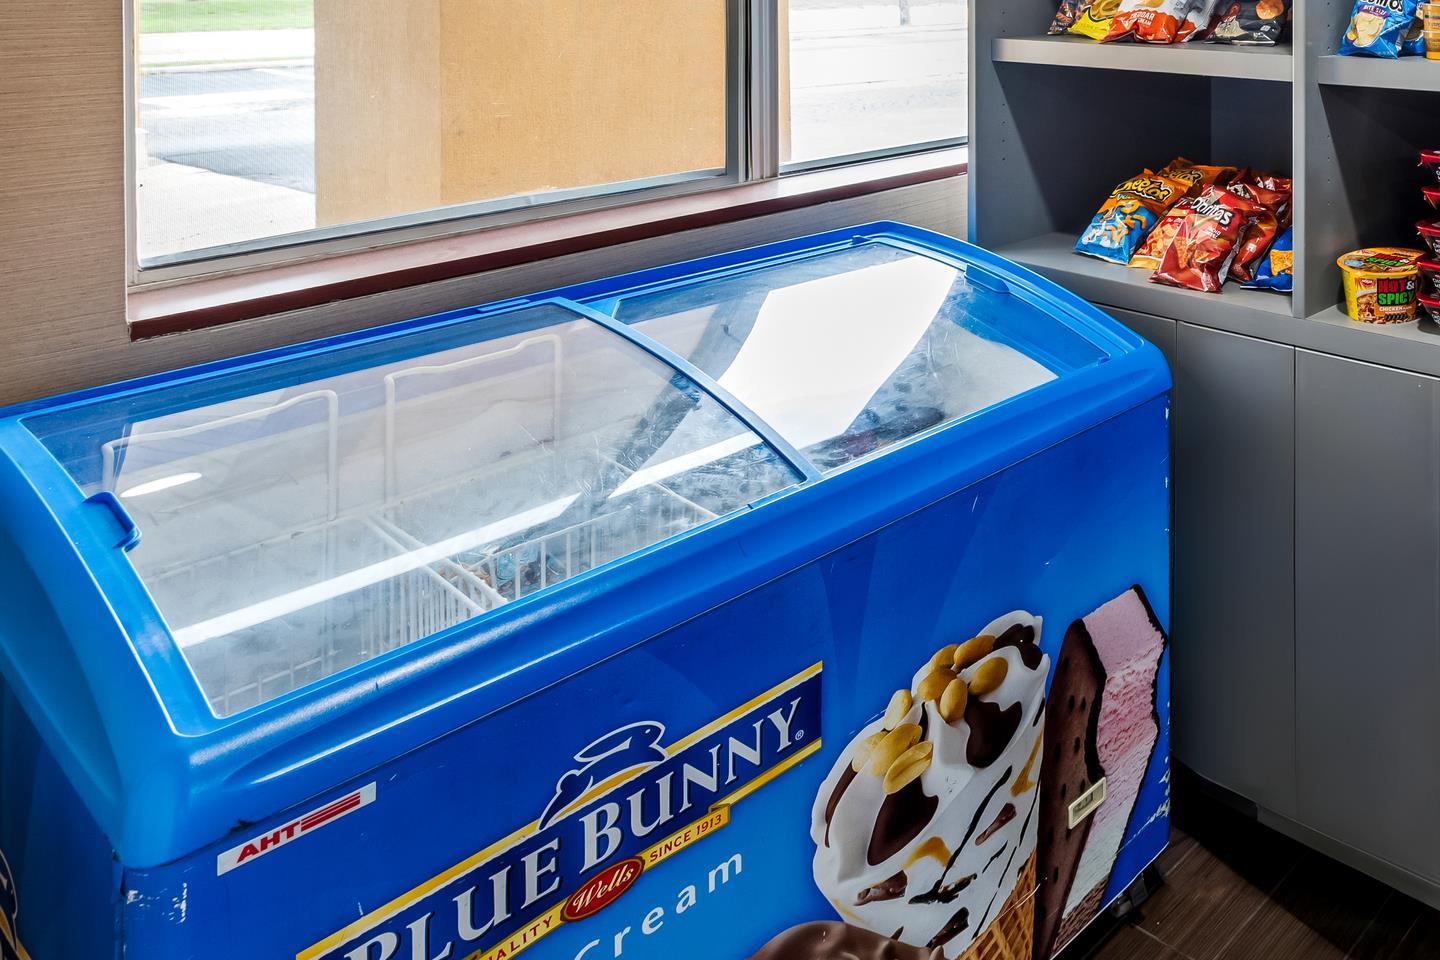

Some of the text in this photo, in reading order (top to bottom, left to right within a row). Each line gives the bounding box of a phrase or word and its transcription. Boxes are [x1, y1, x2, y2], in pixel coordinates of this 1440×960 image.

[1363, 5, 1375, 13] BITE
[1191, 196, 1233, 225] Doritos
[1378, 278, 1406, 293] HOT
[1406, 280, 1415, 290] &
[1378, 292, 1414, 305] SPICY
[579, 696, 803, 875] BUNNY
[237, 819, 301, 864] AHT
[649, 812, 724, 864] SINCE 1913
[571, 863, 634, 914] Wells
[487, 915, 554, 960] ALITY
